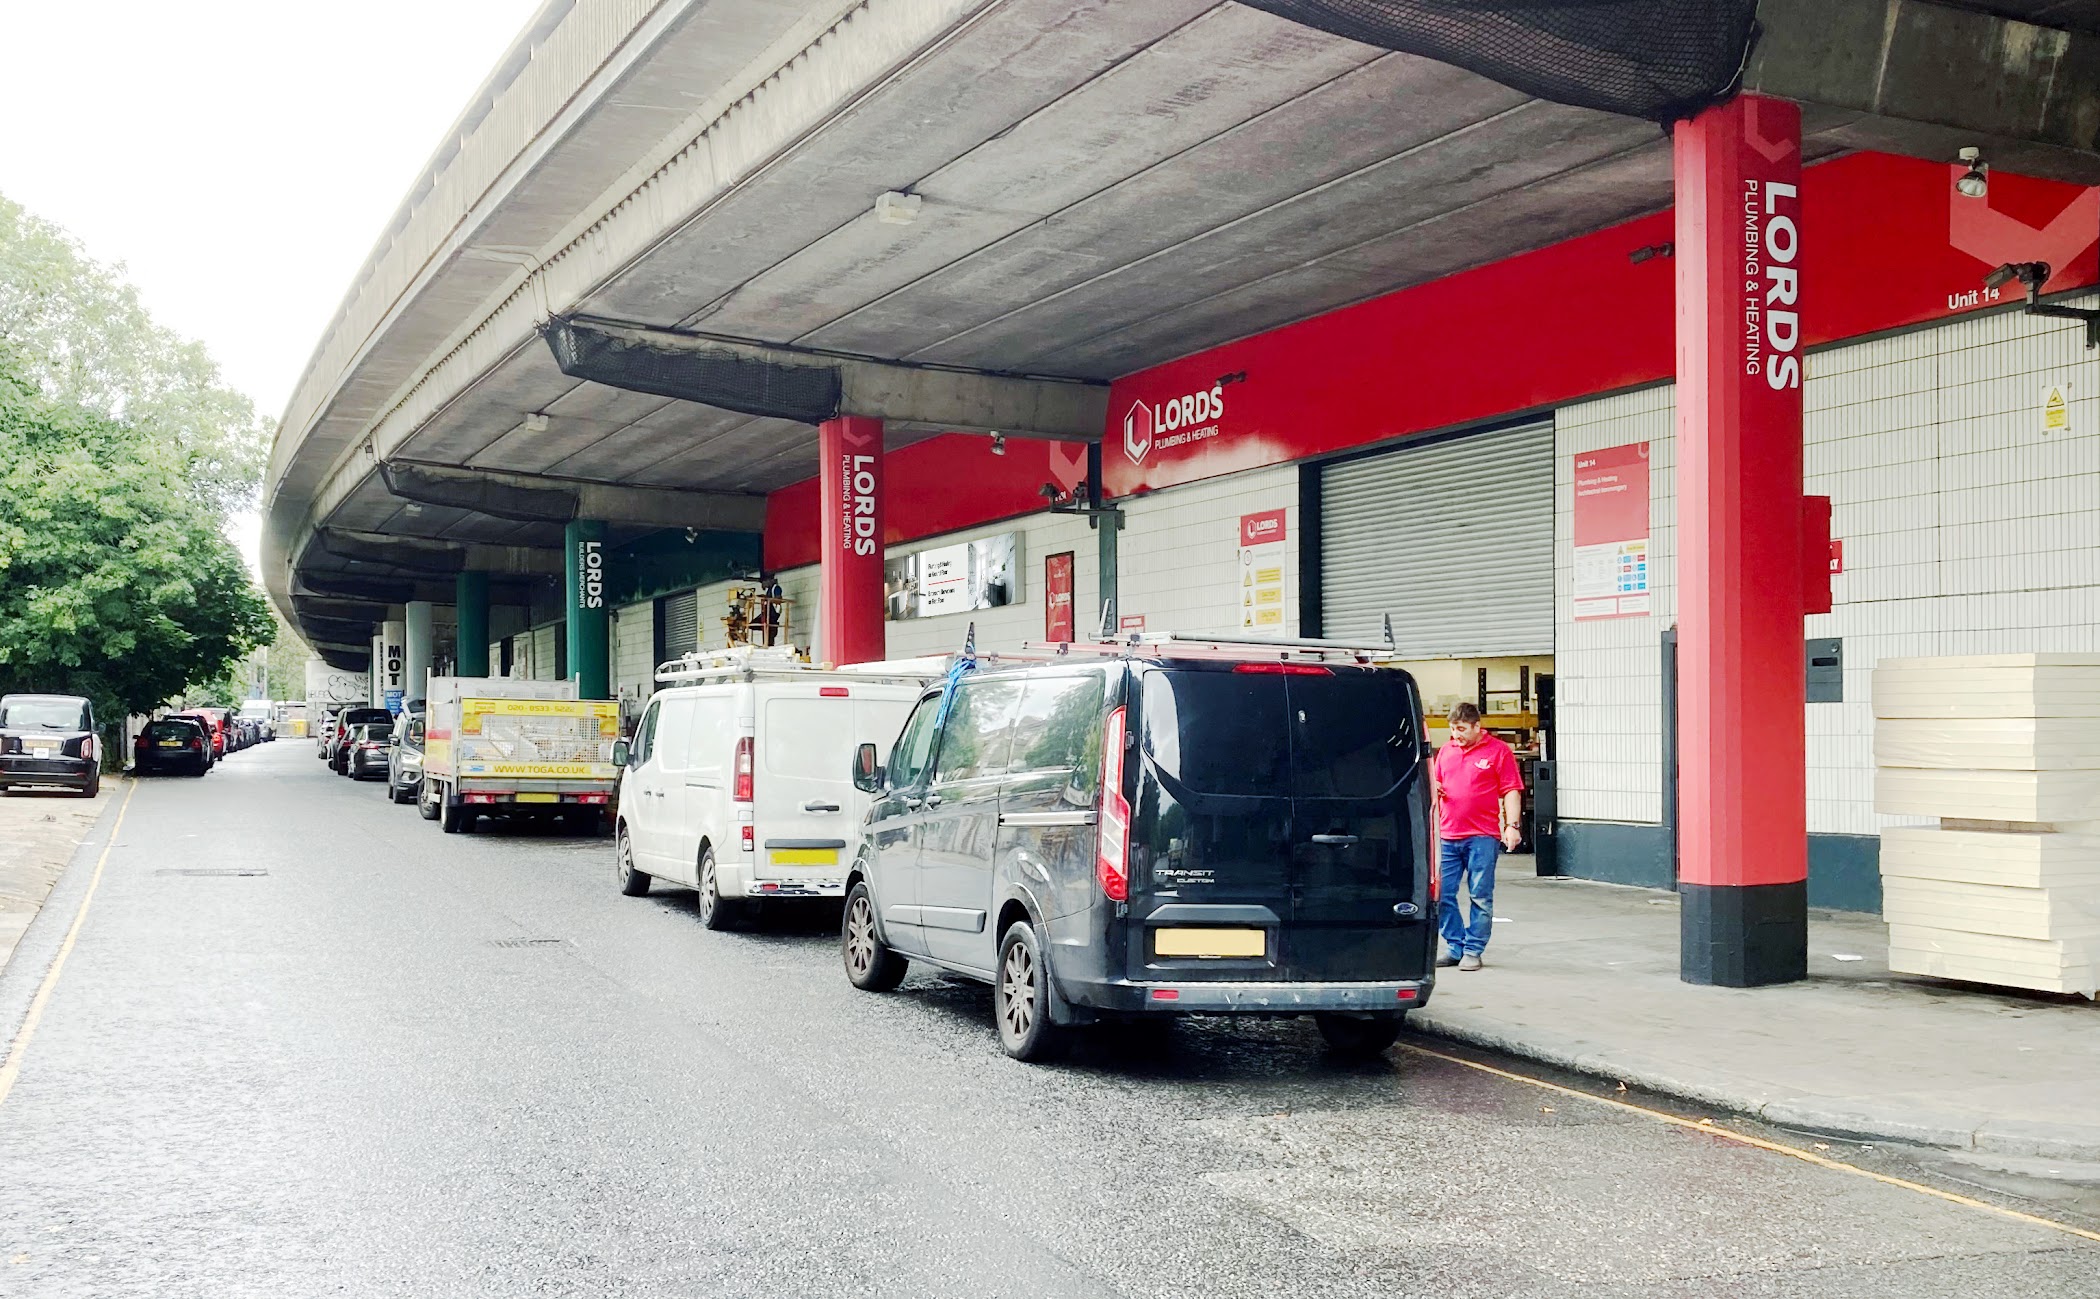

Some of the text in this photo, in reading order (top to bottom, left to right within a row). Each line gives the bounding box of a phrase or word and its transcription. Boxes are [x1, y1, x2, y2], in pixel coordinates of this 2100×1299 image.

[1745, 179, 1760, 375] PLUMBING & HEATING
[1765, 181, 1799, 390] LORDS
[1948, 287, 2000, 310] Unit 14
[1155, 386, 1223, 434] LORDS
[1155, 425, 1218, 450] PLUMBING & HEATING
[842, 454, 851, 502] PLUMBING
[854, 455, 876, 556] LORDS
[1256, 519, 1278, 531] LORDS
[843, 511, 851, 549] HEATING
[586, 542, 603, 609] LORDS
[388, 645, 401, 686] MOT
[494, 765, 585, 775] WWW.TOGA.CO.UK
